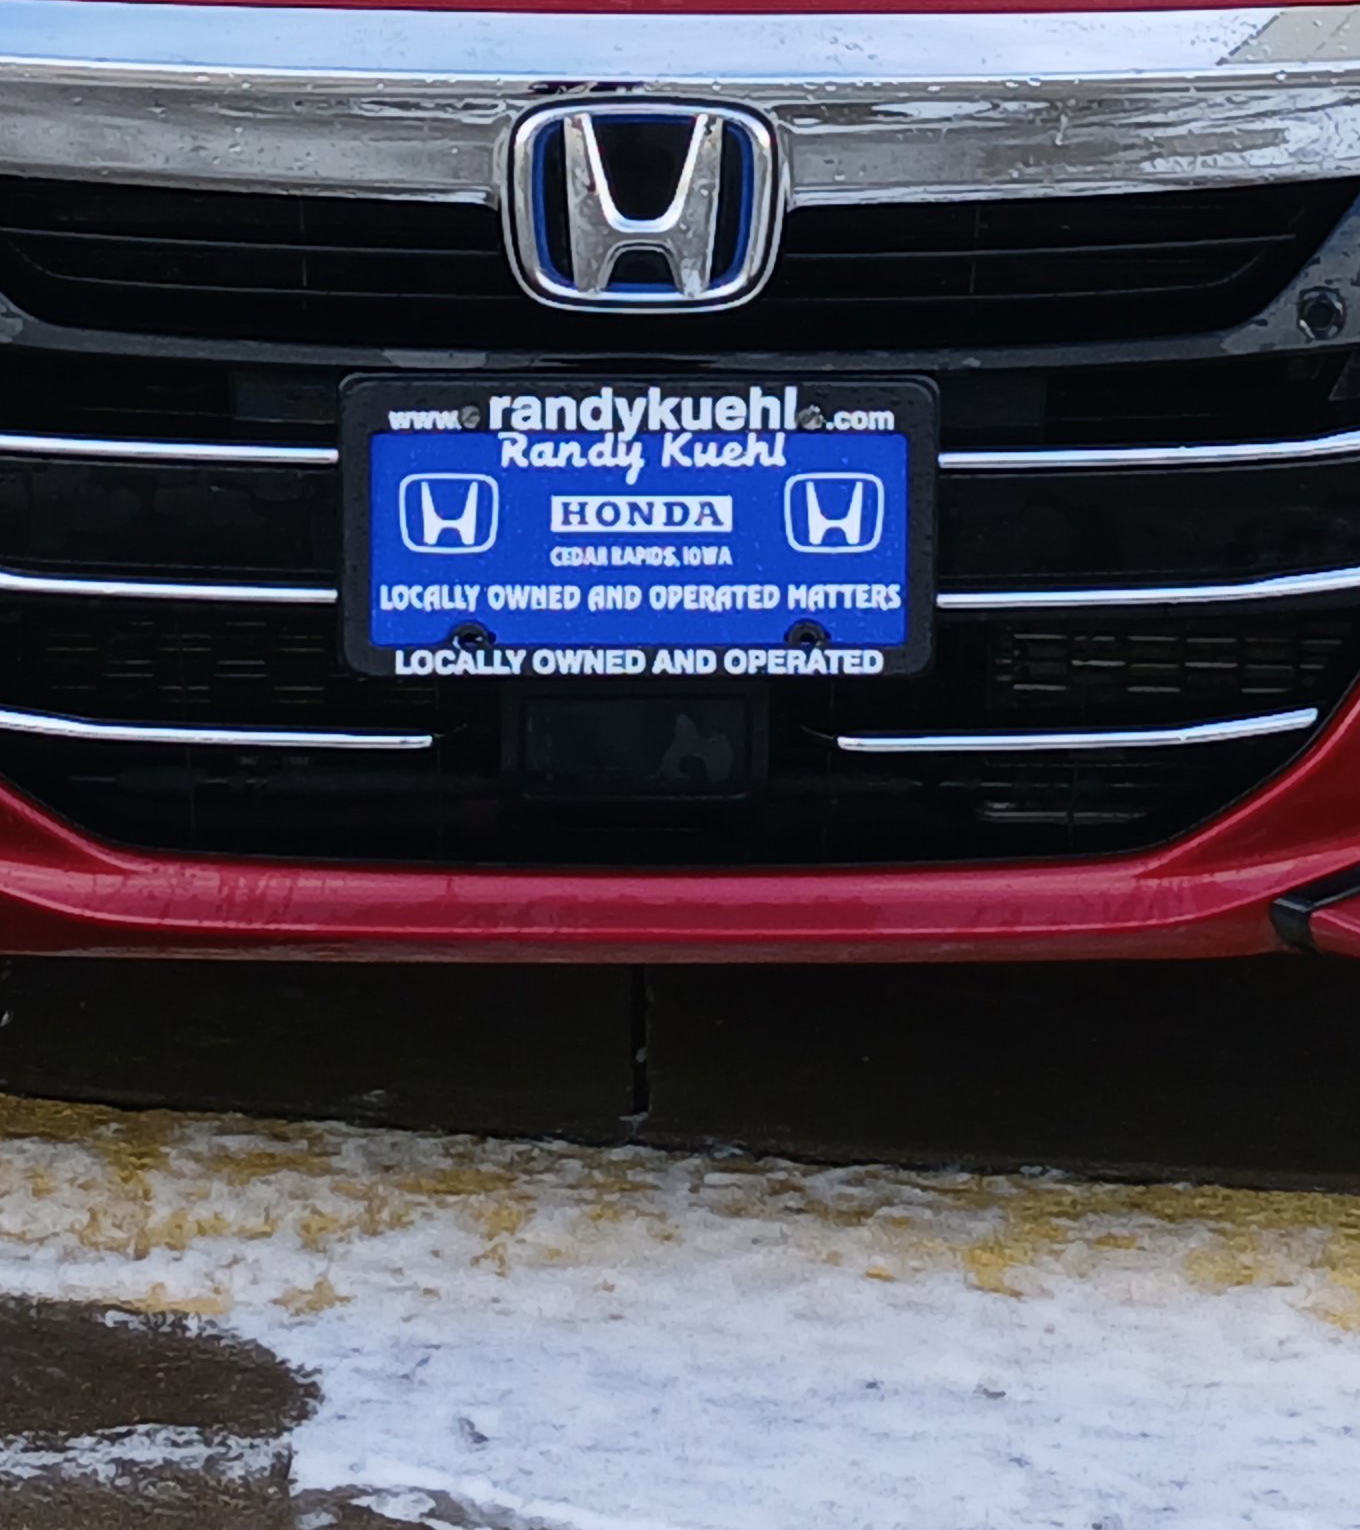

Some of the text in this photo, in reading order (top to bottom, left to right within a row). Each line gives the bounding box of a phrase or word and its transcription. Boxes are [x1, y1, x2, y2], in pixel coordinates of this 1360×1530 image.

[489, 386, 798, 441] randykuehl
[825, 410, 895, 430] .com
[497, 432, 787, 486] Randy Kuehl
[561, 501, 725, 527] HONDA
[550, 546, 609, 567] CEDAR
[683, 546, 733, 566] IOWA
[380, 583, 902, 612] LOCALLY OWNED AND OPERATED MATTERS
[395, 648, 884, 676] LOCALLY OWNED AND OPERATED
